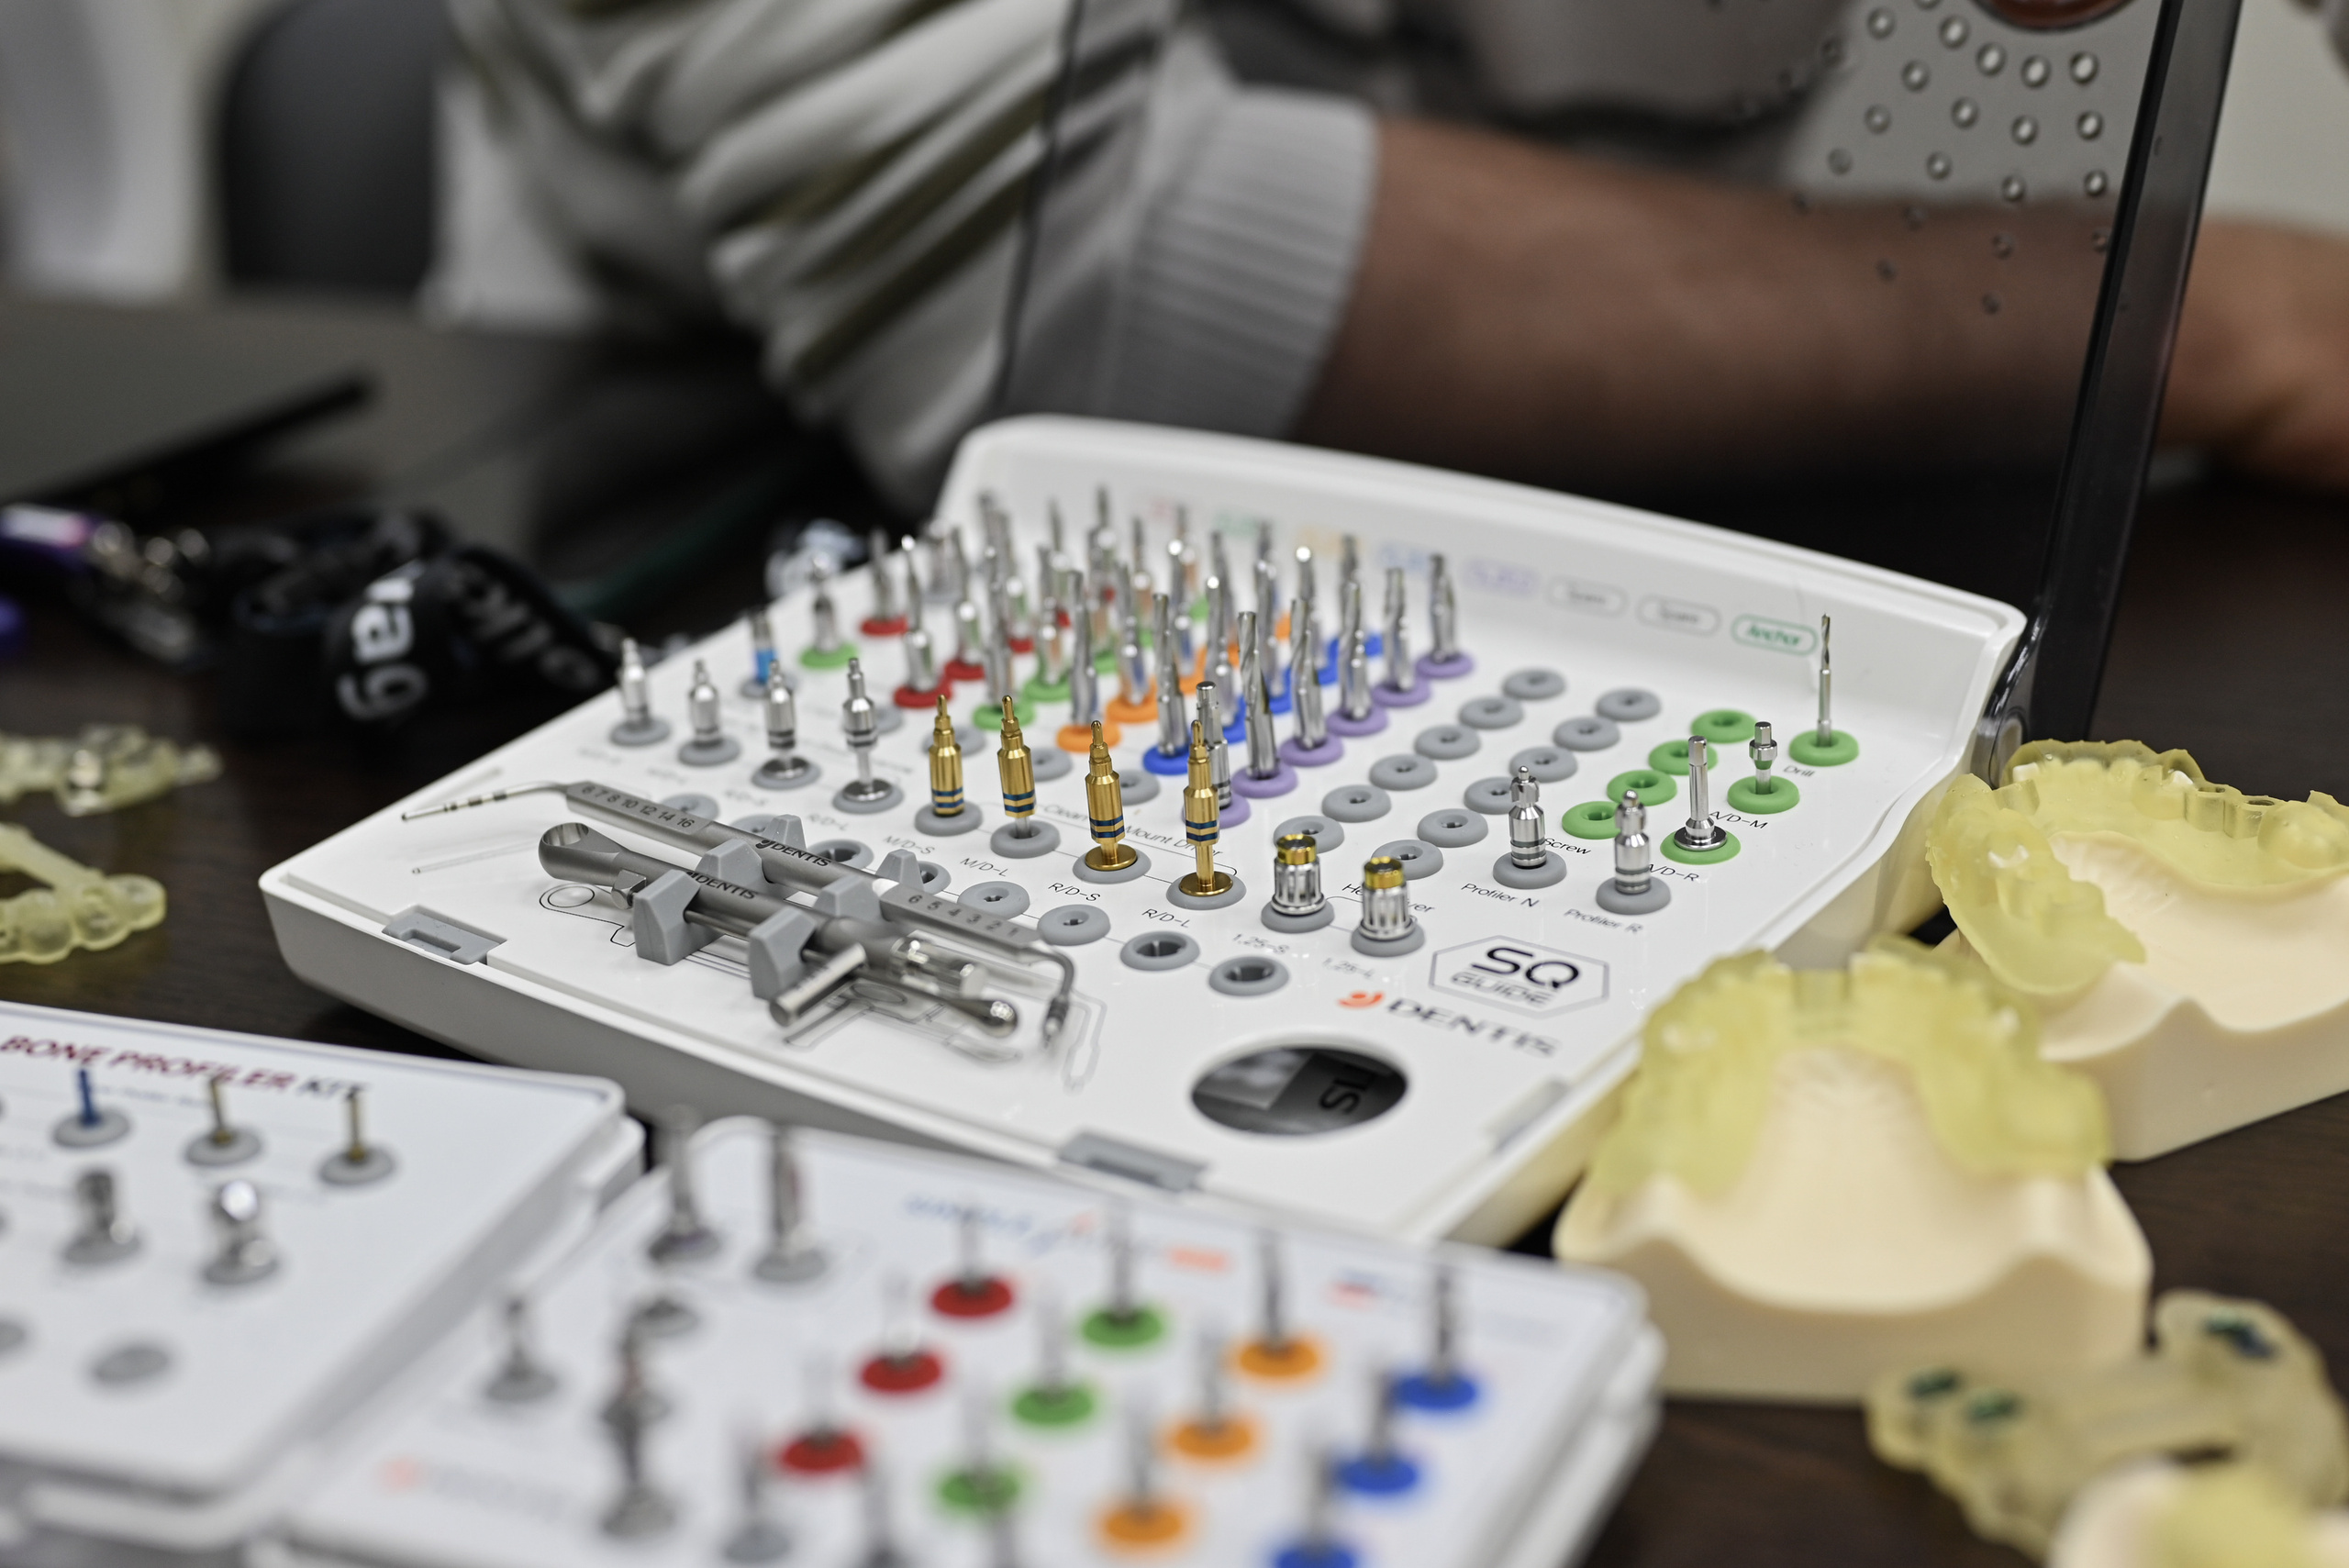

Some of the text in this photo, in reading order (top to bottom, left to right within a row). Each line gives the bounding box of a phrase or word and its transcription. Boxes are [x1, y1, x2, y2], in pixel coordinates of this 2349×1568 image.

[1783, 765, 1816, 777] Drill
[607, 794, 621, 804] 8
[621, 797, 640, 809] 10
[640, 805, 658, 817] 12
[658, 811, 676, 822] 14
[677, 817, 696, 828] 16
[1709, 810, 1769, 830] A/D-M
[1124, 825, 1174, 844] Mount
[772, 843, 831, 867] DENTIS
[883, 835, 936, 856] M/D-S
[1544, 838, 1592, 855] Screw
[960, 857, 1010, 878] M/D-L
[696, 873, 759, 900] DENTIS
[1047, 882, 1102, 903] R/D-S
[1462, 883, 1540, 907] Profiler N
[908, 894, 923, 905] 6
[1141, 908, 1191, 929] R/D-L
[1564, 908, 1623, 929] Profiler
[1471, 946, 1580, 990] SQ
[1451, 970, 1557, 1006] GUIDE
[1387, 997, 1562, 1059] DENTIS
[0, 1035, 112, 1065] BONE
[107, 1049, 297, 1092] PROFILER
